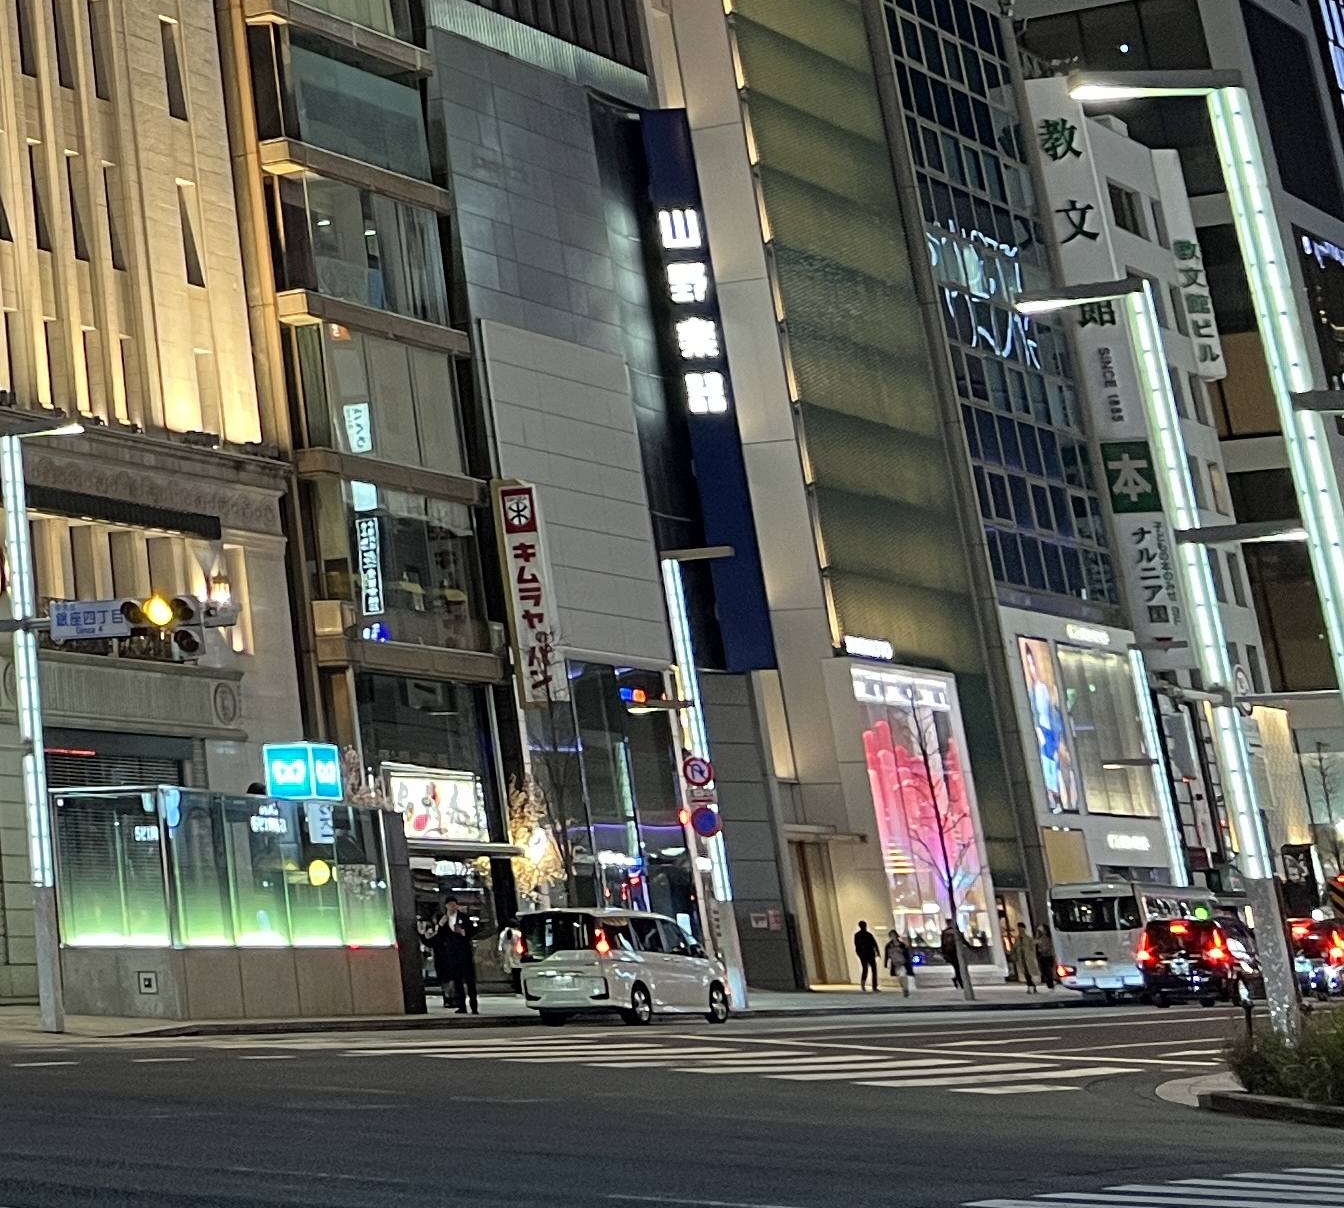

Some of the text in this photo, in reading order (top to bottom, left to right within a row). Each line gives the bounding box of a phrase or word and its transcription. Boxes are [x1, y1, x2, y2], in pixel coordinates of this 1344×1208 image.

[1173, 239, 1220, 365] 教文館ビル
[1097, 346, 1118, 389] SINCE
[1106, 452, 1153, 503] 本
[1131, 526, 1169, 623] ナルニア国
[55, 609, 123, 627] 銀座四丁目
